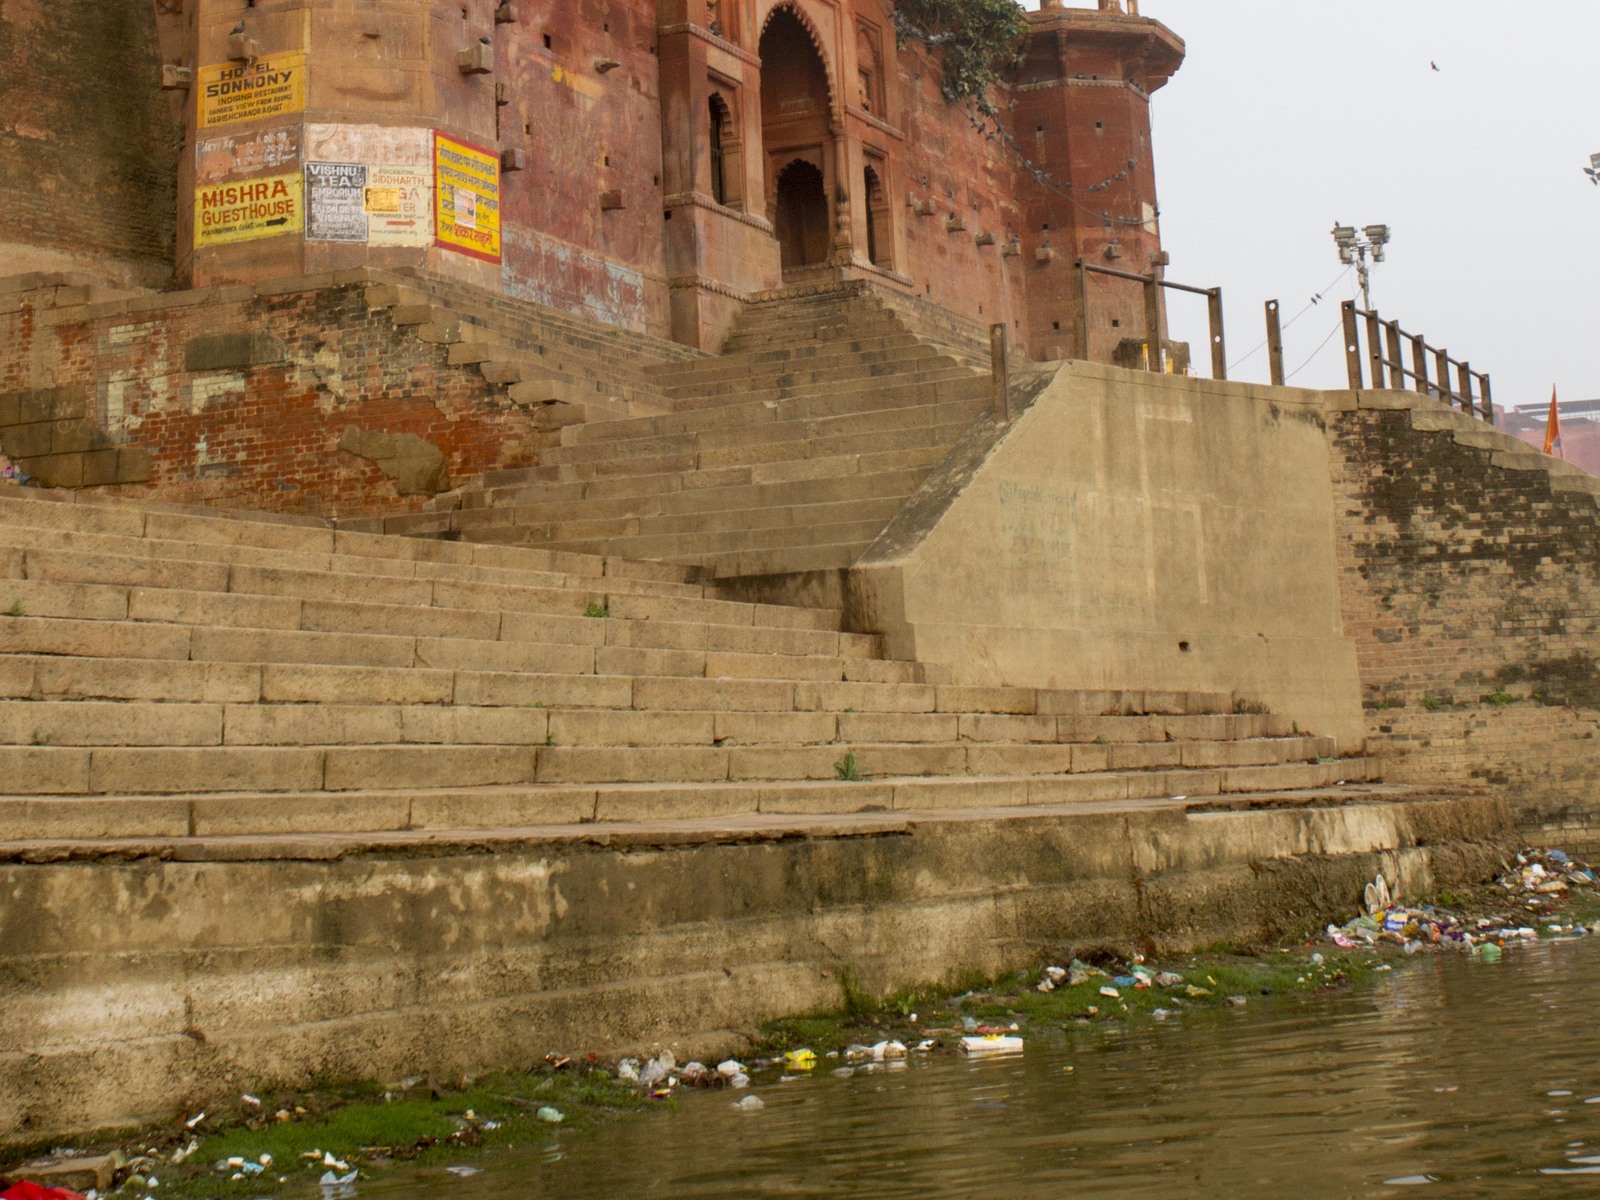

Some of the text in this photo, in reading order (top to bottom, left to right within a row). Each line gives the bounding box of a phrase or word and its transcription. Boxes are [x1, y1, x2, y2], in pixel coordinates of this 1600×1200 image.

[220, 62, 275, 81] HOEL
[206, 70, 293, 98] SONMONY
[217, 92, 253, 106] INDIANA
[236, 100, 256, 111] VIEW
[308, 165, 358, 176] VISHNU
[317, 175, 351, 187] TEA
[372, 173, 425, 186] SIDDHARTH
[202, 179, 289, 210] MISHRA
[312, 186, 361, 199] EMPORIUM
[399, 187, 421, 201] GA
[202, 199, 295, 226] GUESTHOUSE
